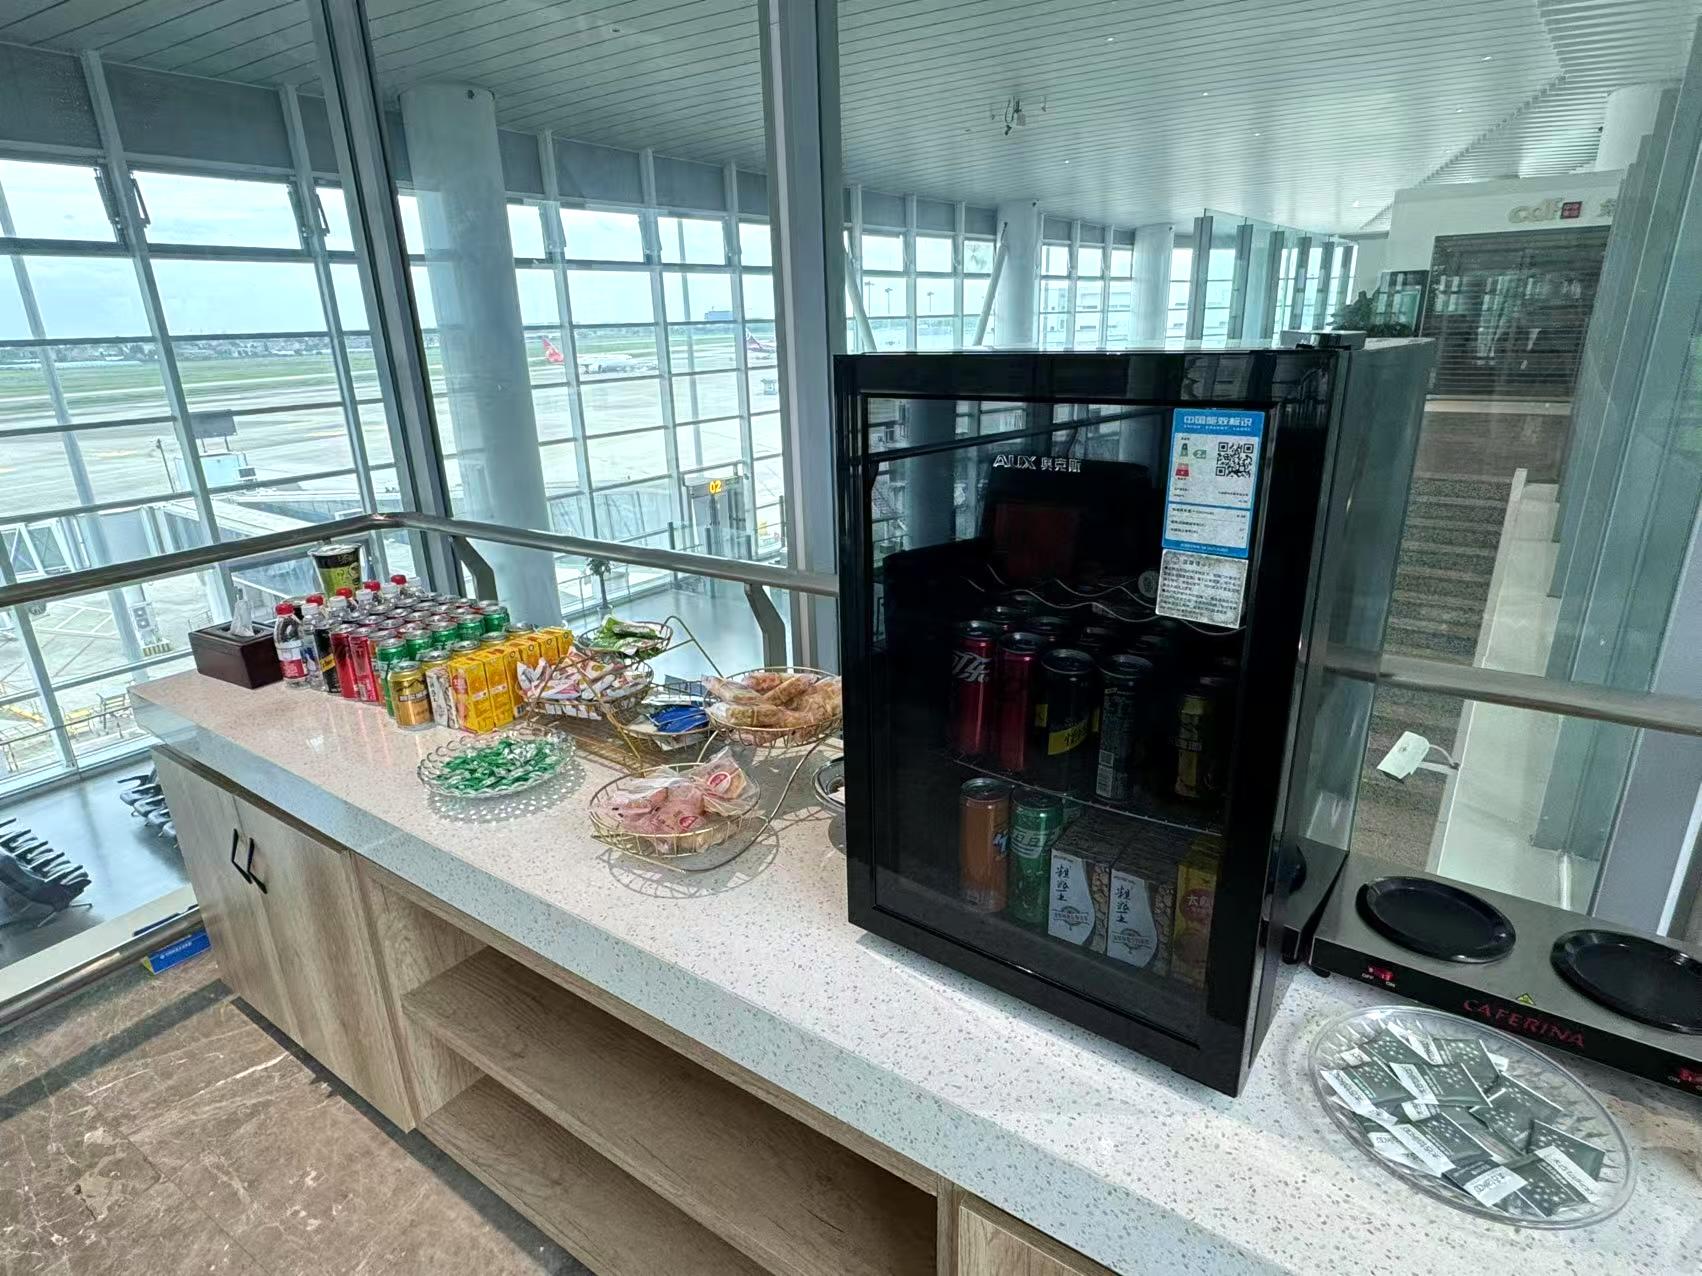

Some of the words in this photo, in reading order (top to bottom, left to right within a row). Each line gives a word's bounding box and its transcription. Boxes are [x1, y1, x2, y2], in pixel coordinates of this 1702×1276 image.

[992, 454, 1037, 470] AUX
[1040, 457, 1081, 473] 奥克斯
[709, 479, 722, 494] 02
[1463, 999, 1584, 1048] CAFERINA
